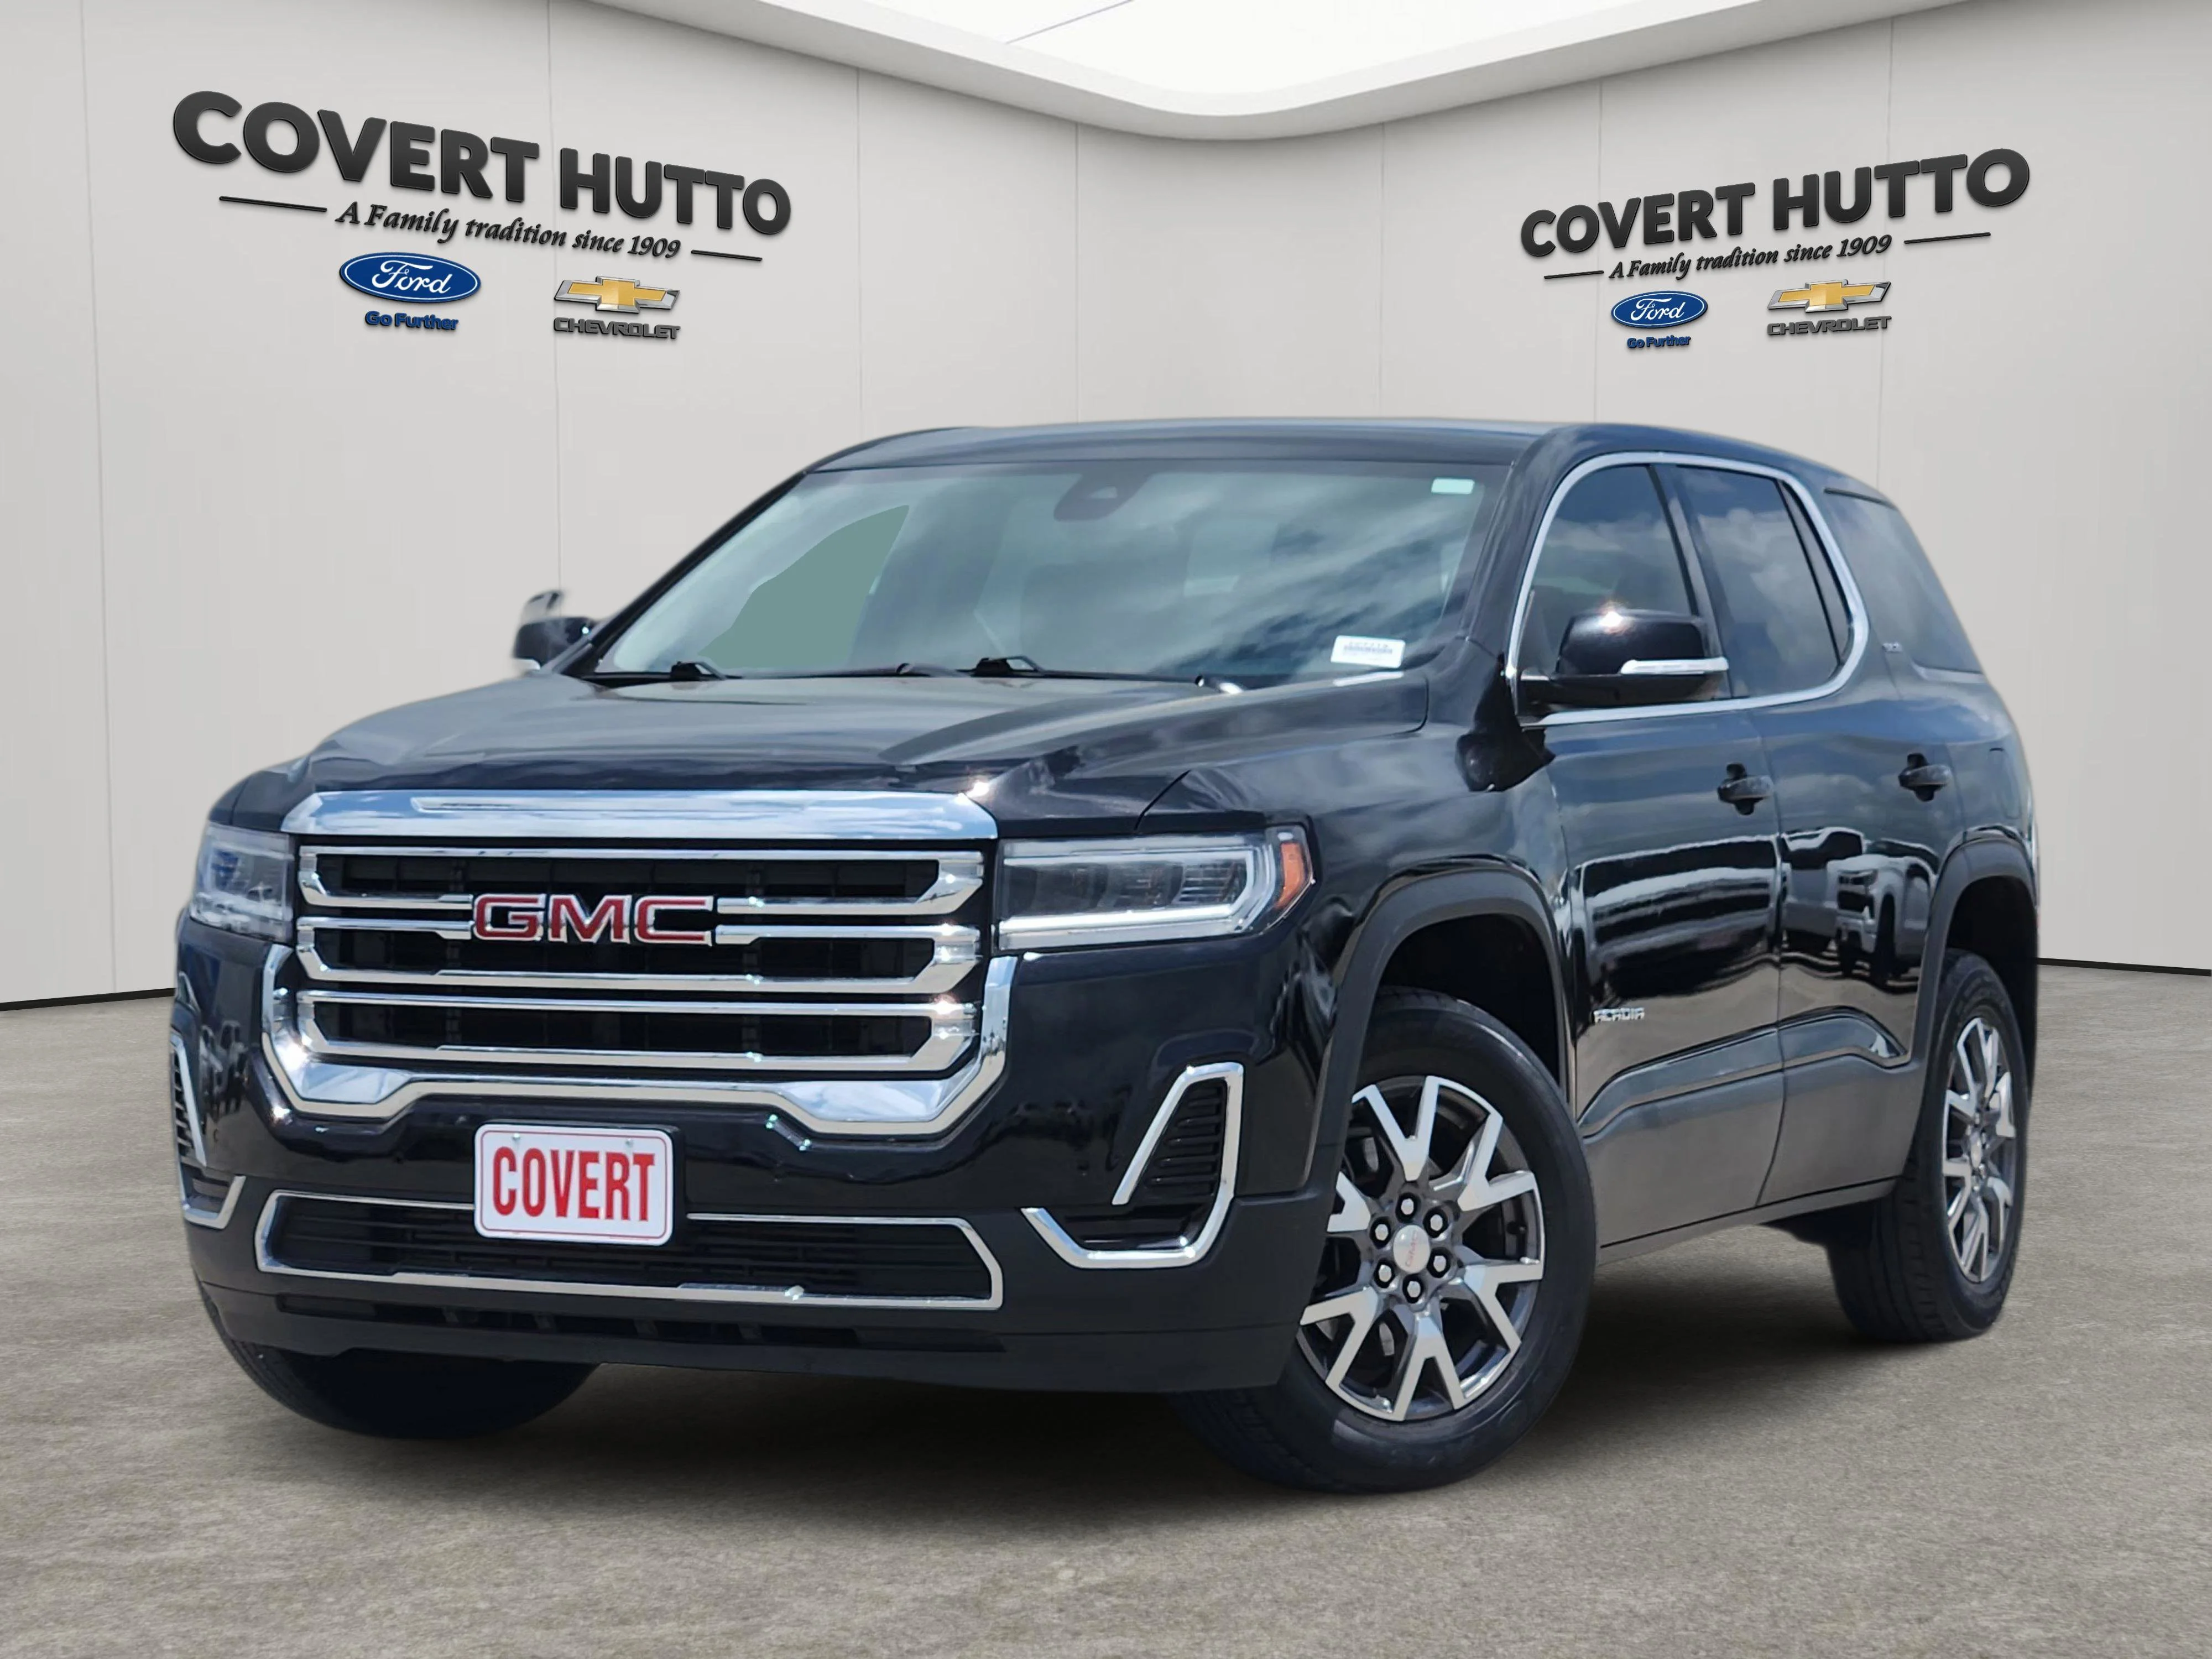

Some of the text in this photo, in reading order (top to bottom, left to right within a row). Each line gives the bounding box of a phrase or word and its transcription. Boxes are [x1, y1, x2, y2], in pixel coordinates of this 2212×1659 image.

[173, 91, 791, 236] COVERT HUTTO
[1521, 149, 2030, 258] COVERT HUTTO
[335, 201, 681, 258] A Family tradition since 1909
[1608, 234, 1892, 281] A Family tradition since 1909
[371, 260, 451, 295] Ford
[365, 310, 459, 331] Go Further
[1630, 296, 1686, 322] Ford
[1767, 315, 1892, 336] CHEVROLET
[554, 317, 681, 340] CHEVROLET
[1626, 334, 1691, 349] Go Further
[473, 893, 714, 947] GMC
[1593, 1007, 1645, 1022] ACADIA
[493, 1146, 655, 1222] COVERT
